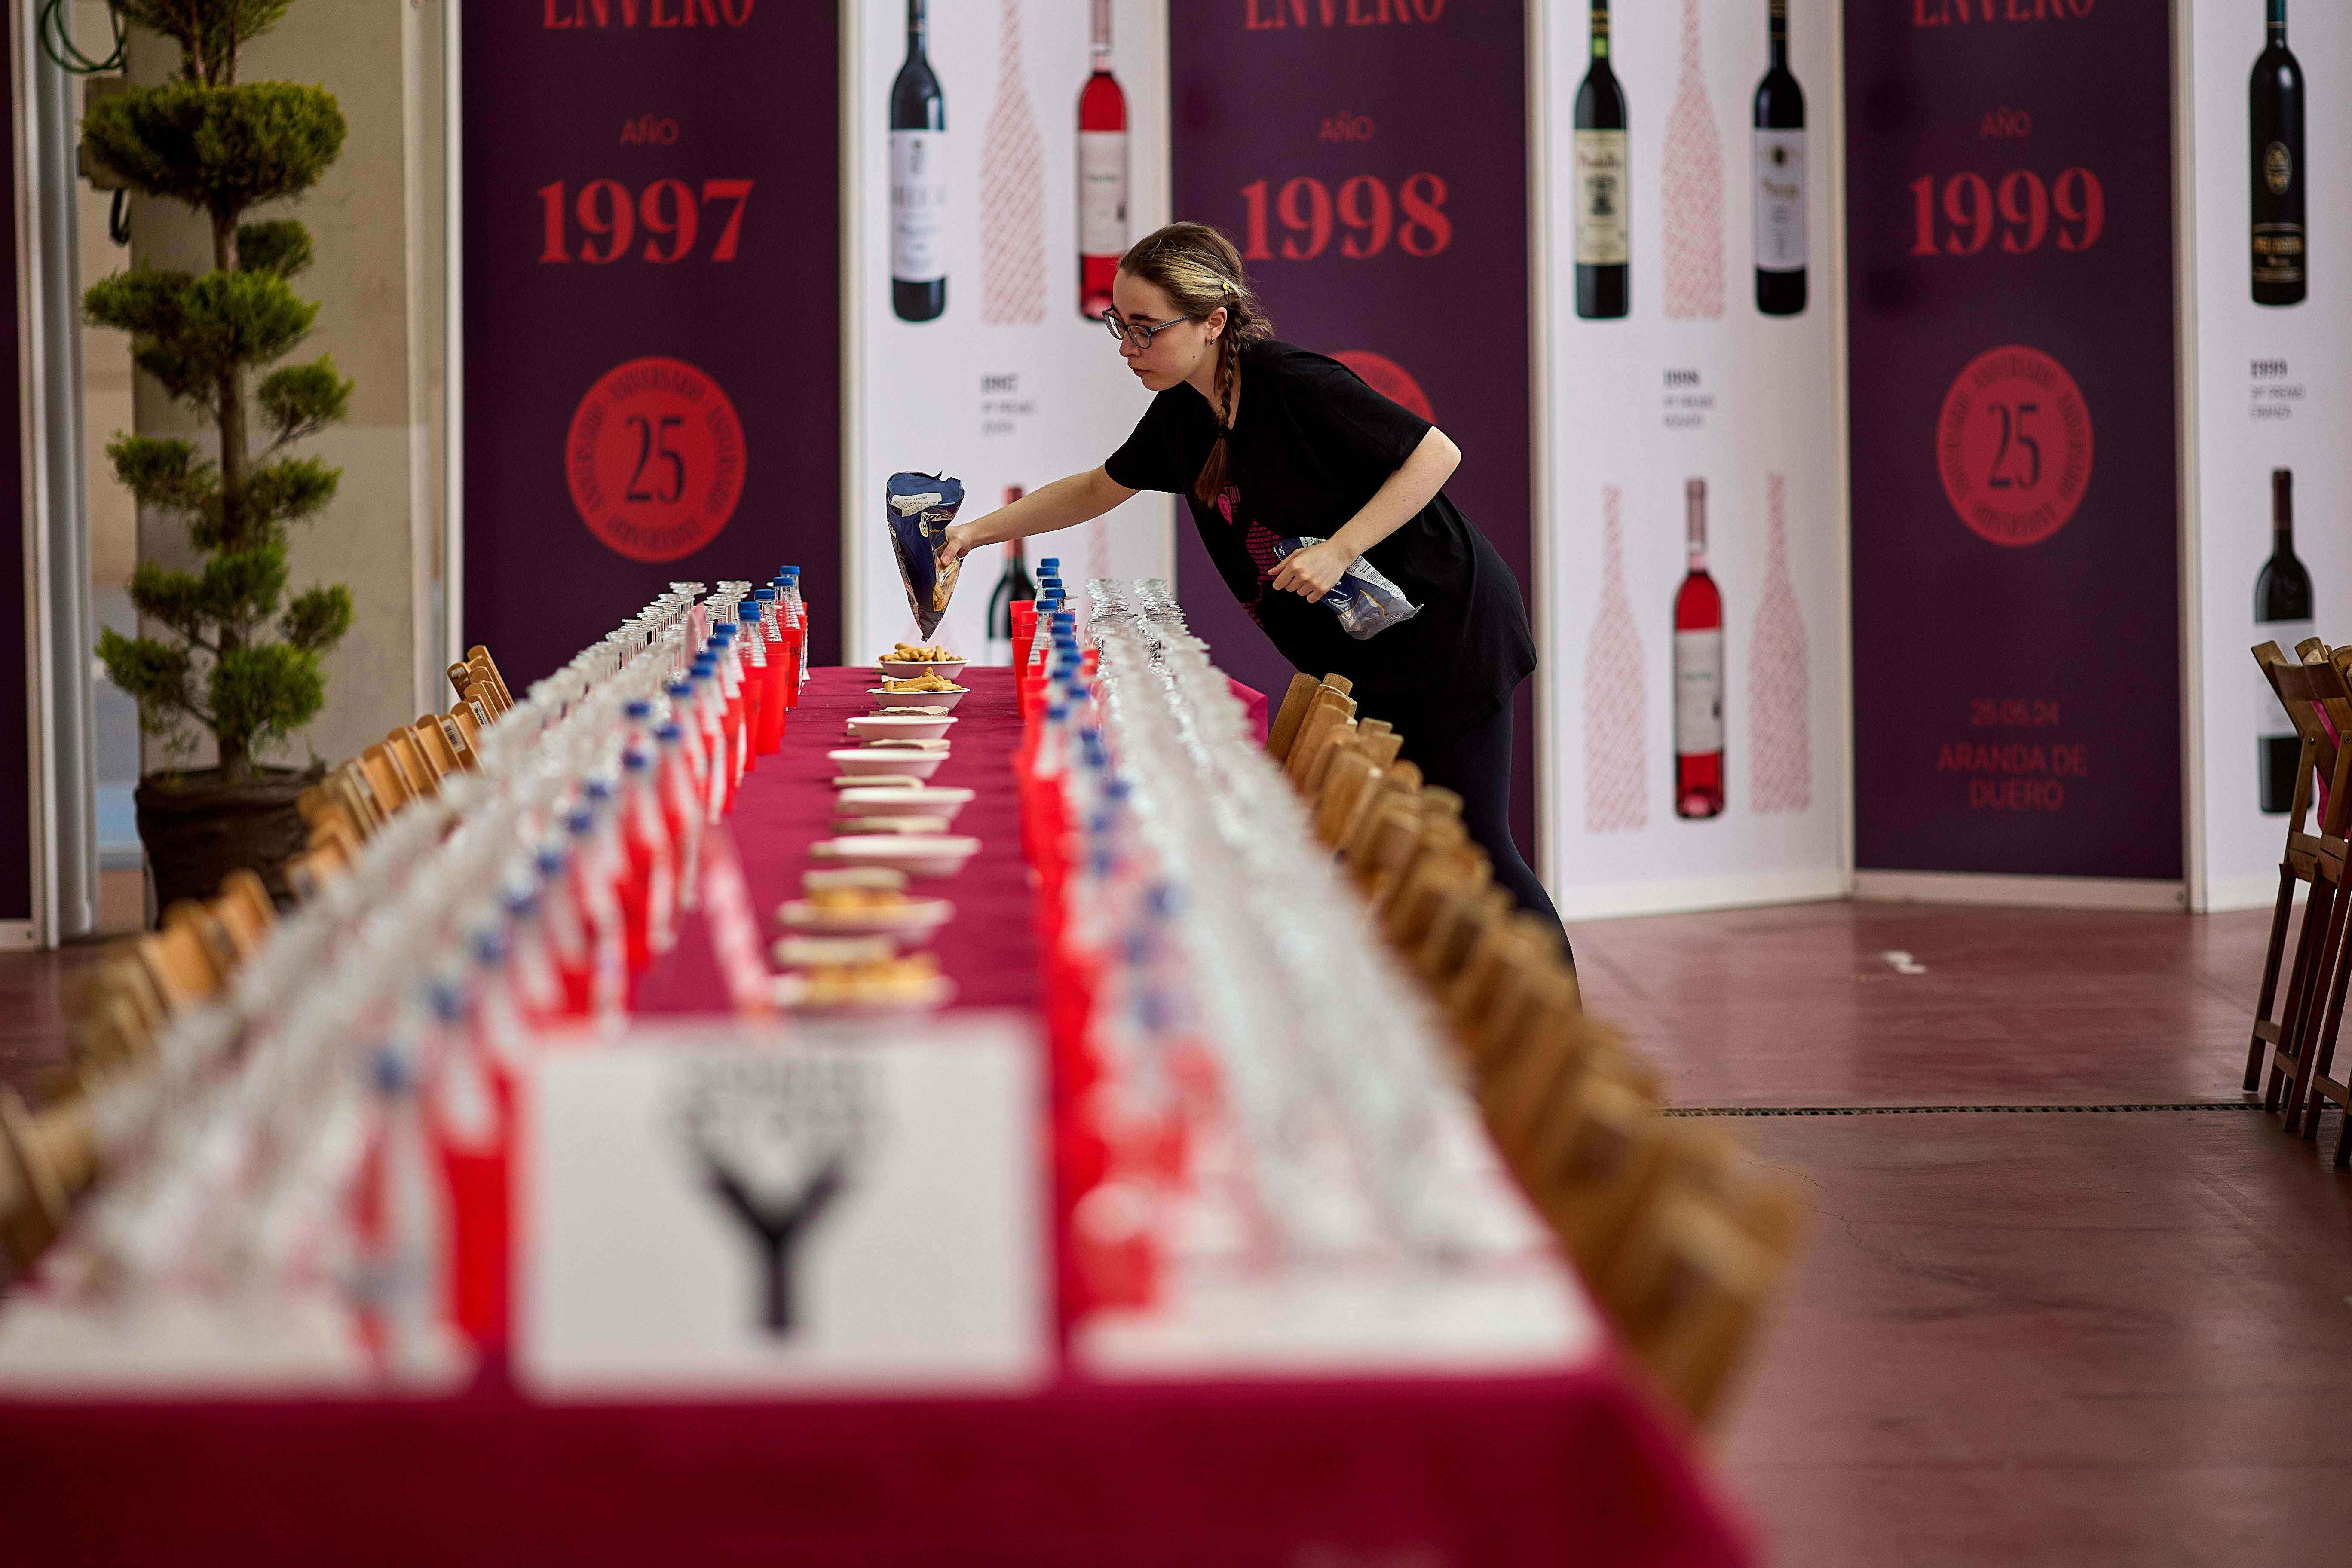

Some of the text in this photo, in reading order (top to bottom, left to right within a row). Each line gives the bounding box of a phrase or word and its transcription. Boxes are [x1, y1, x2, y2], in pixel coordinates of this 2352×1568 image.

[619, 113, 679, 146] AÑO
[1318, 111, 1375, 142] AÑO
[1979, 106, 2032, 137] AÑO
[536, 178, 755, 264] 1997
[1239, 173, 1452, 260] 1998
[1909, 167, 2105, 257] 1999
[625, 414, 687, 504] 25
[1988, 401, 2042, 490] 25
[1937, 742, 2086, 776] ARANDA DE
[1969, 777, 2064, 810] DUERO
[703, 1152, 851, 1339] Y
